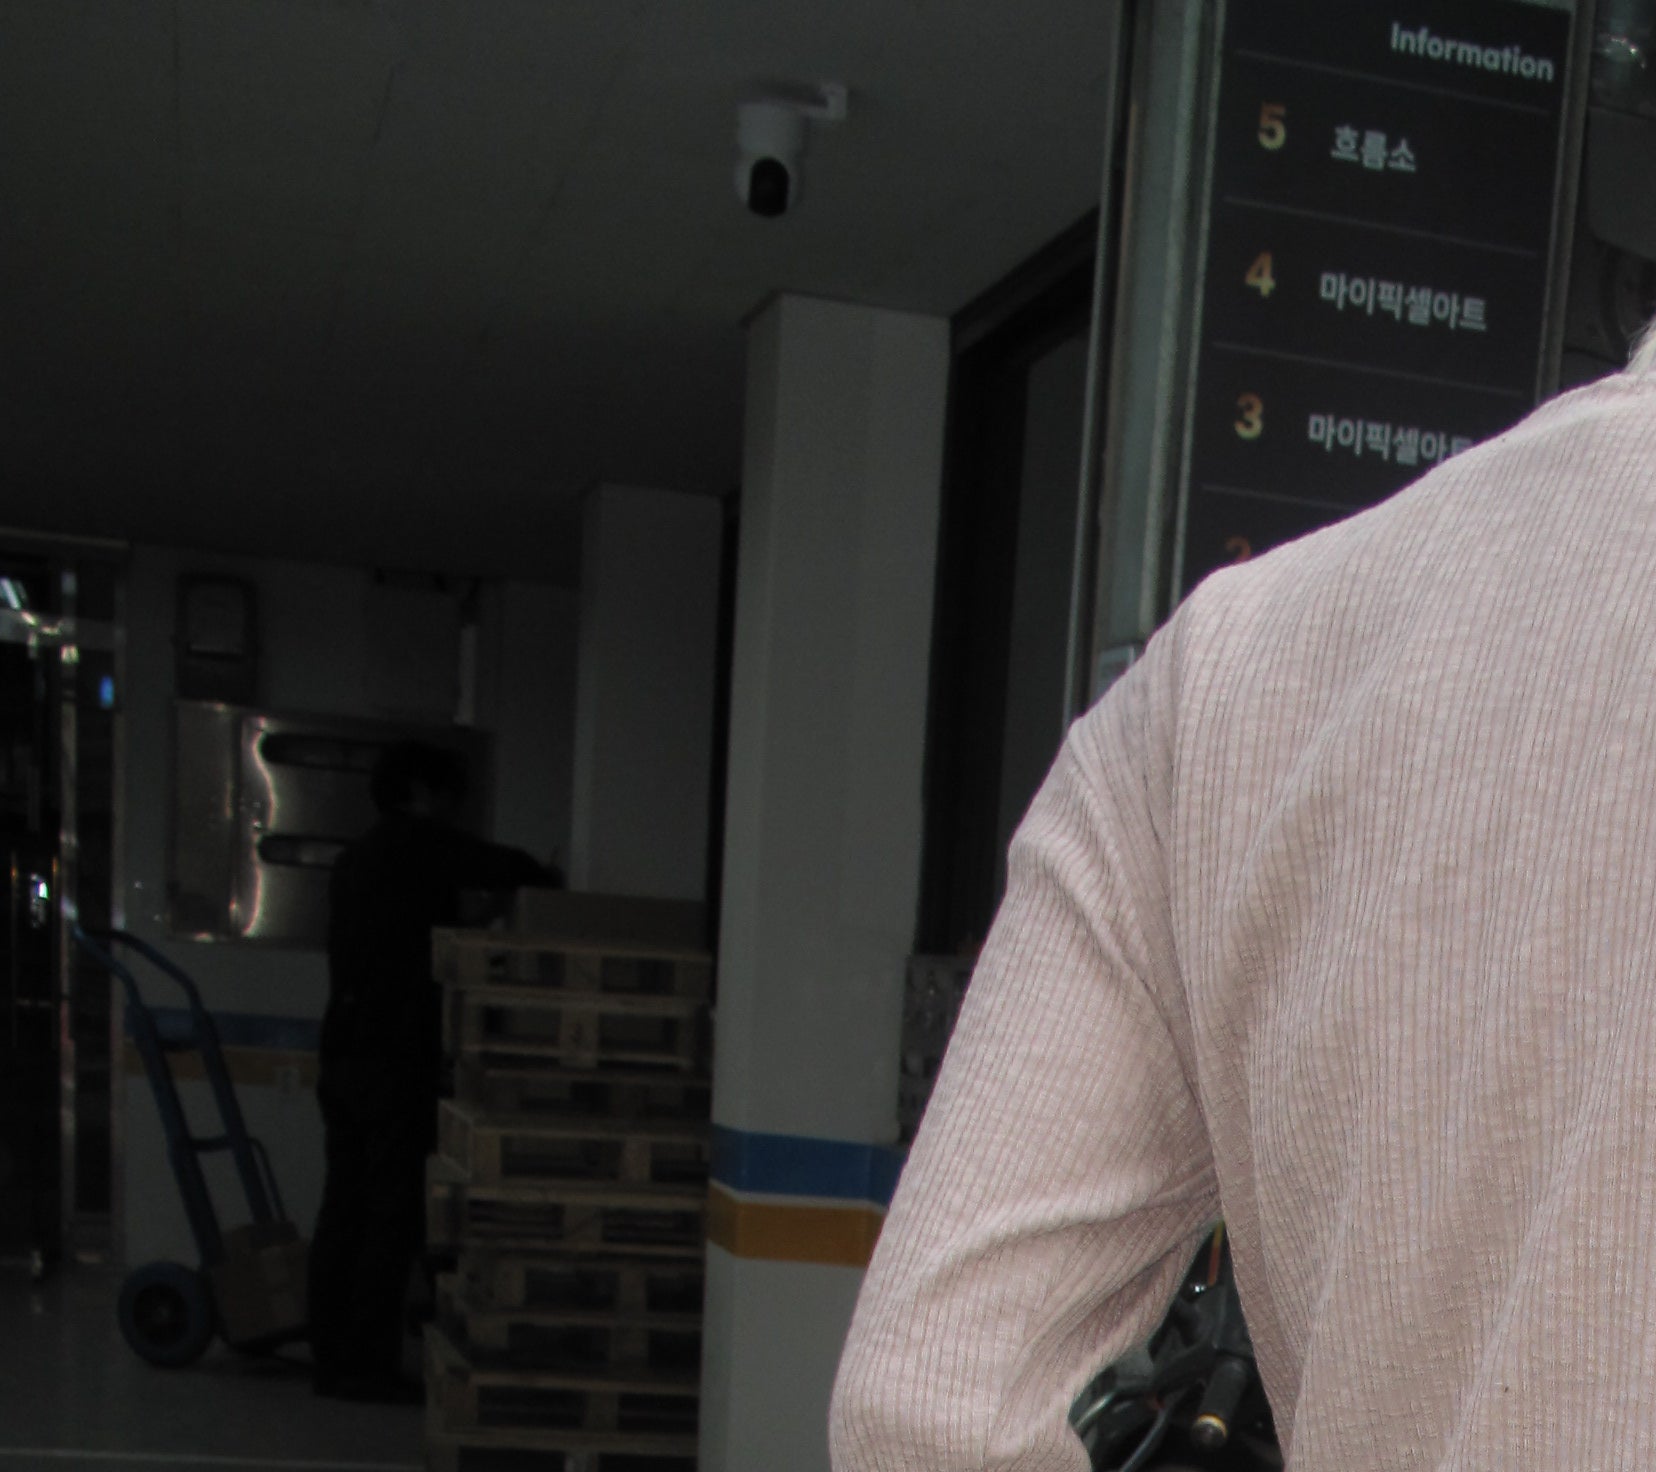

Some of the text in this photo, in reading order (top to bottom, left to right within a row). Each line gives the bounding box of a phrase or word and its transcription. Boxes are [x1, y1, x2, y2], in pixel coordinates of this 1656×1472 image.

[1391, 21, 1554, 81] Information
[1258, 102, 1286, 150] 5
[1245, 251, 1487, 331] 4 마이픽셀아트
[1234, 393, 1263, 440] 3
